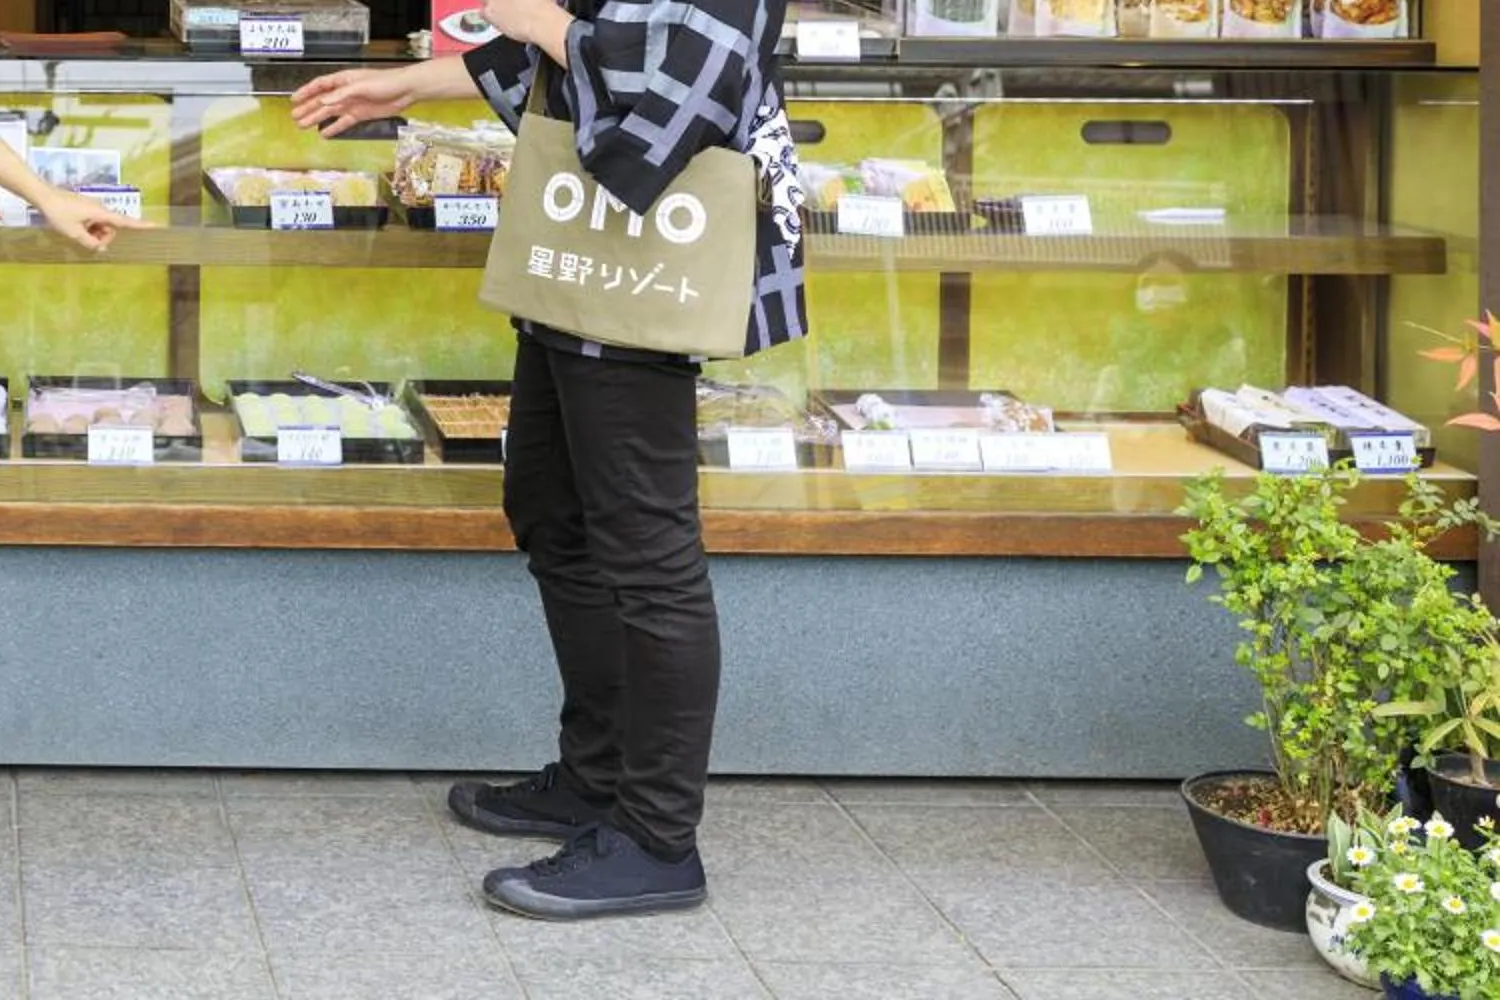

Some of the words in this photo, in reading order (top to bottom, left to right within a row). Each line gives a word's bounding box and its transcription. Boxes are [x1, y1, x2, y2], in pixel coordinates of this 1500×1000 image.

[527, 245, 700, 304] 星野リゾート
